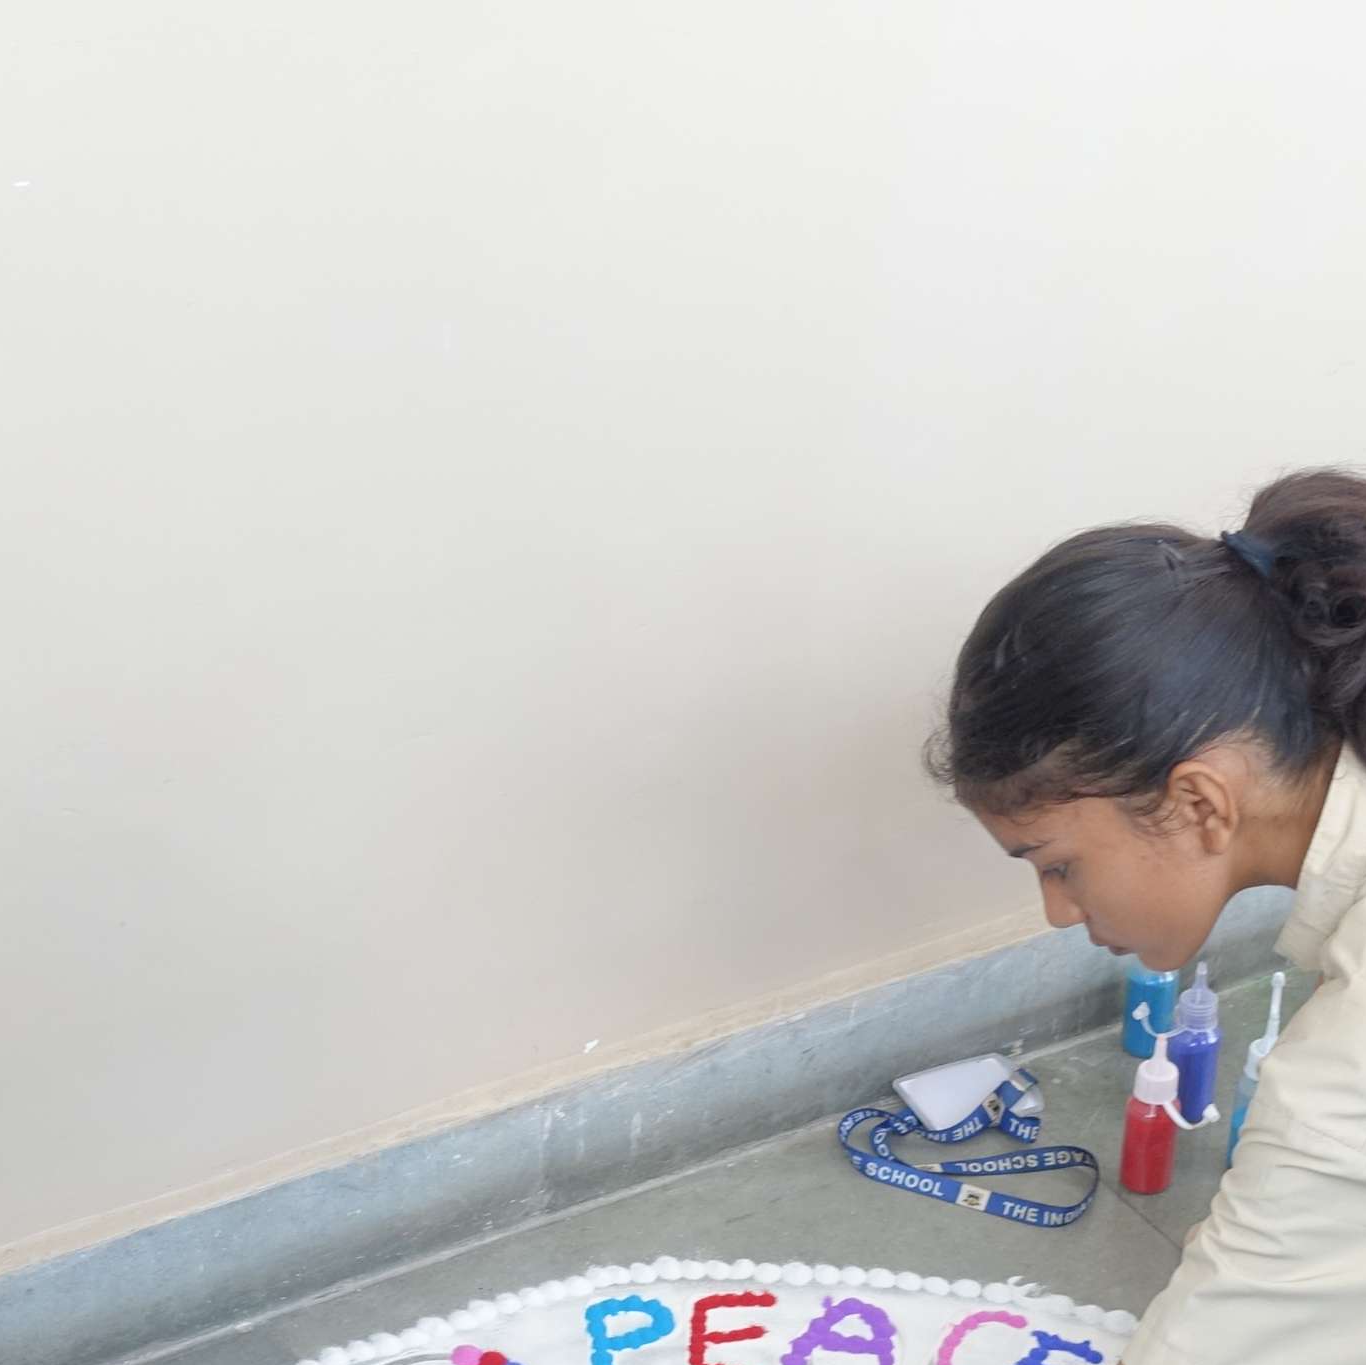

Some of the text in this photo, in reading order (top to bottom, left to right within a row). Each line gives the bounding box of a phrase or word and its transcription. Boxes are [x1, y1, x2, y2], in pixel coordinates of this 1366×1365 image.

[952, 1117, 983, 1142] THE
[954, 1154, 1039, 1172] SCHOOL
[865, 1161, 945, 1197] SCHOOL
[1002, 1201, 1038, 1223] THE
